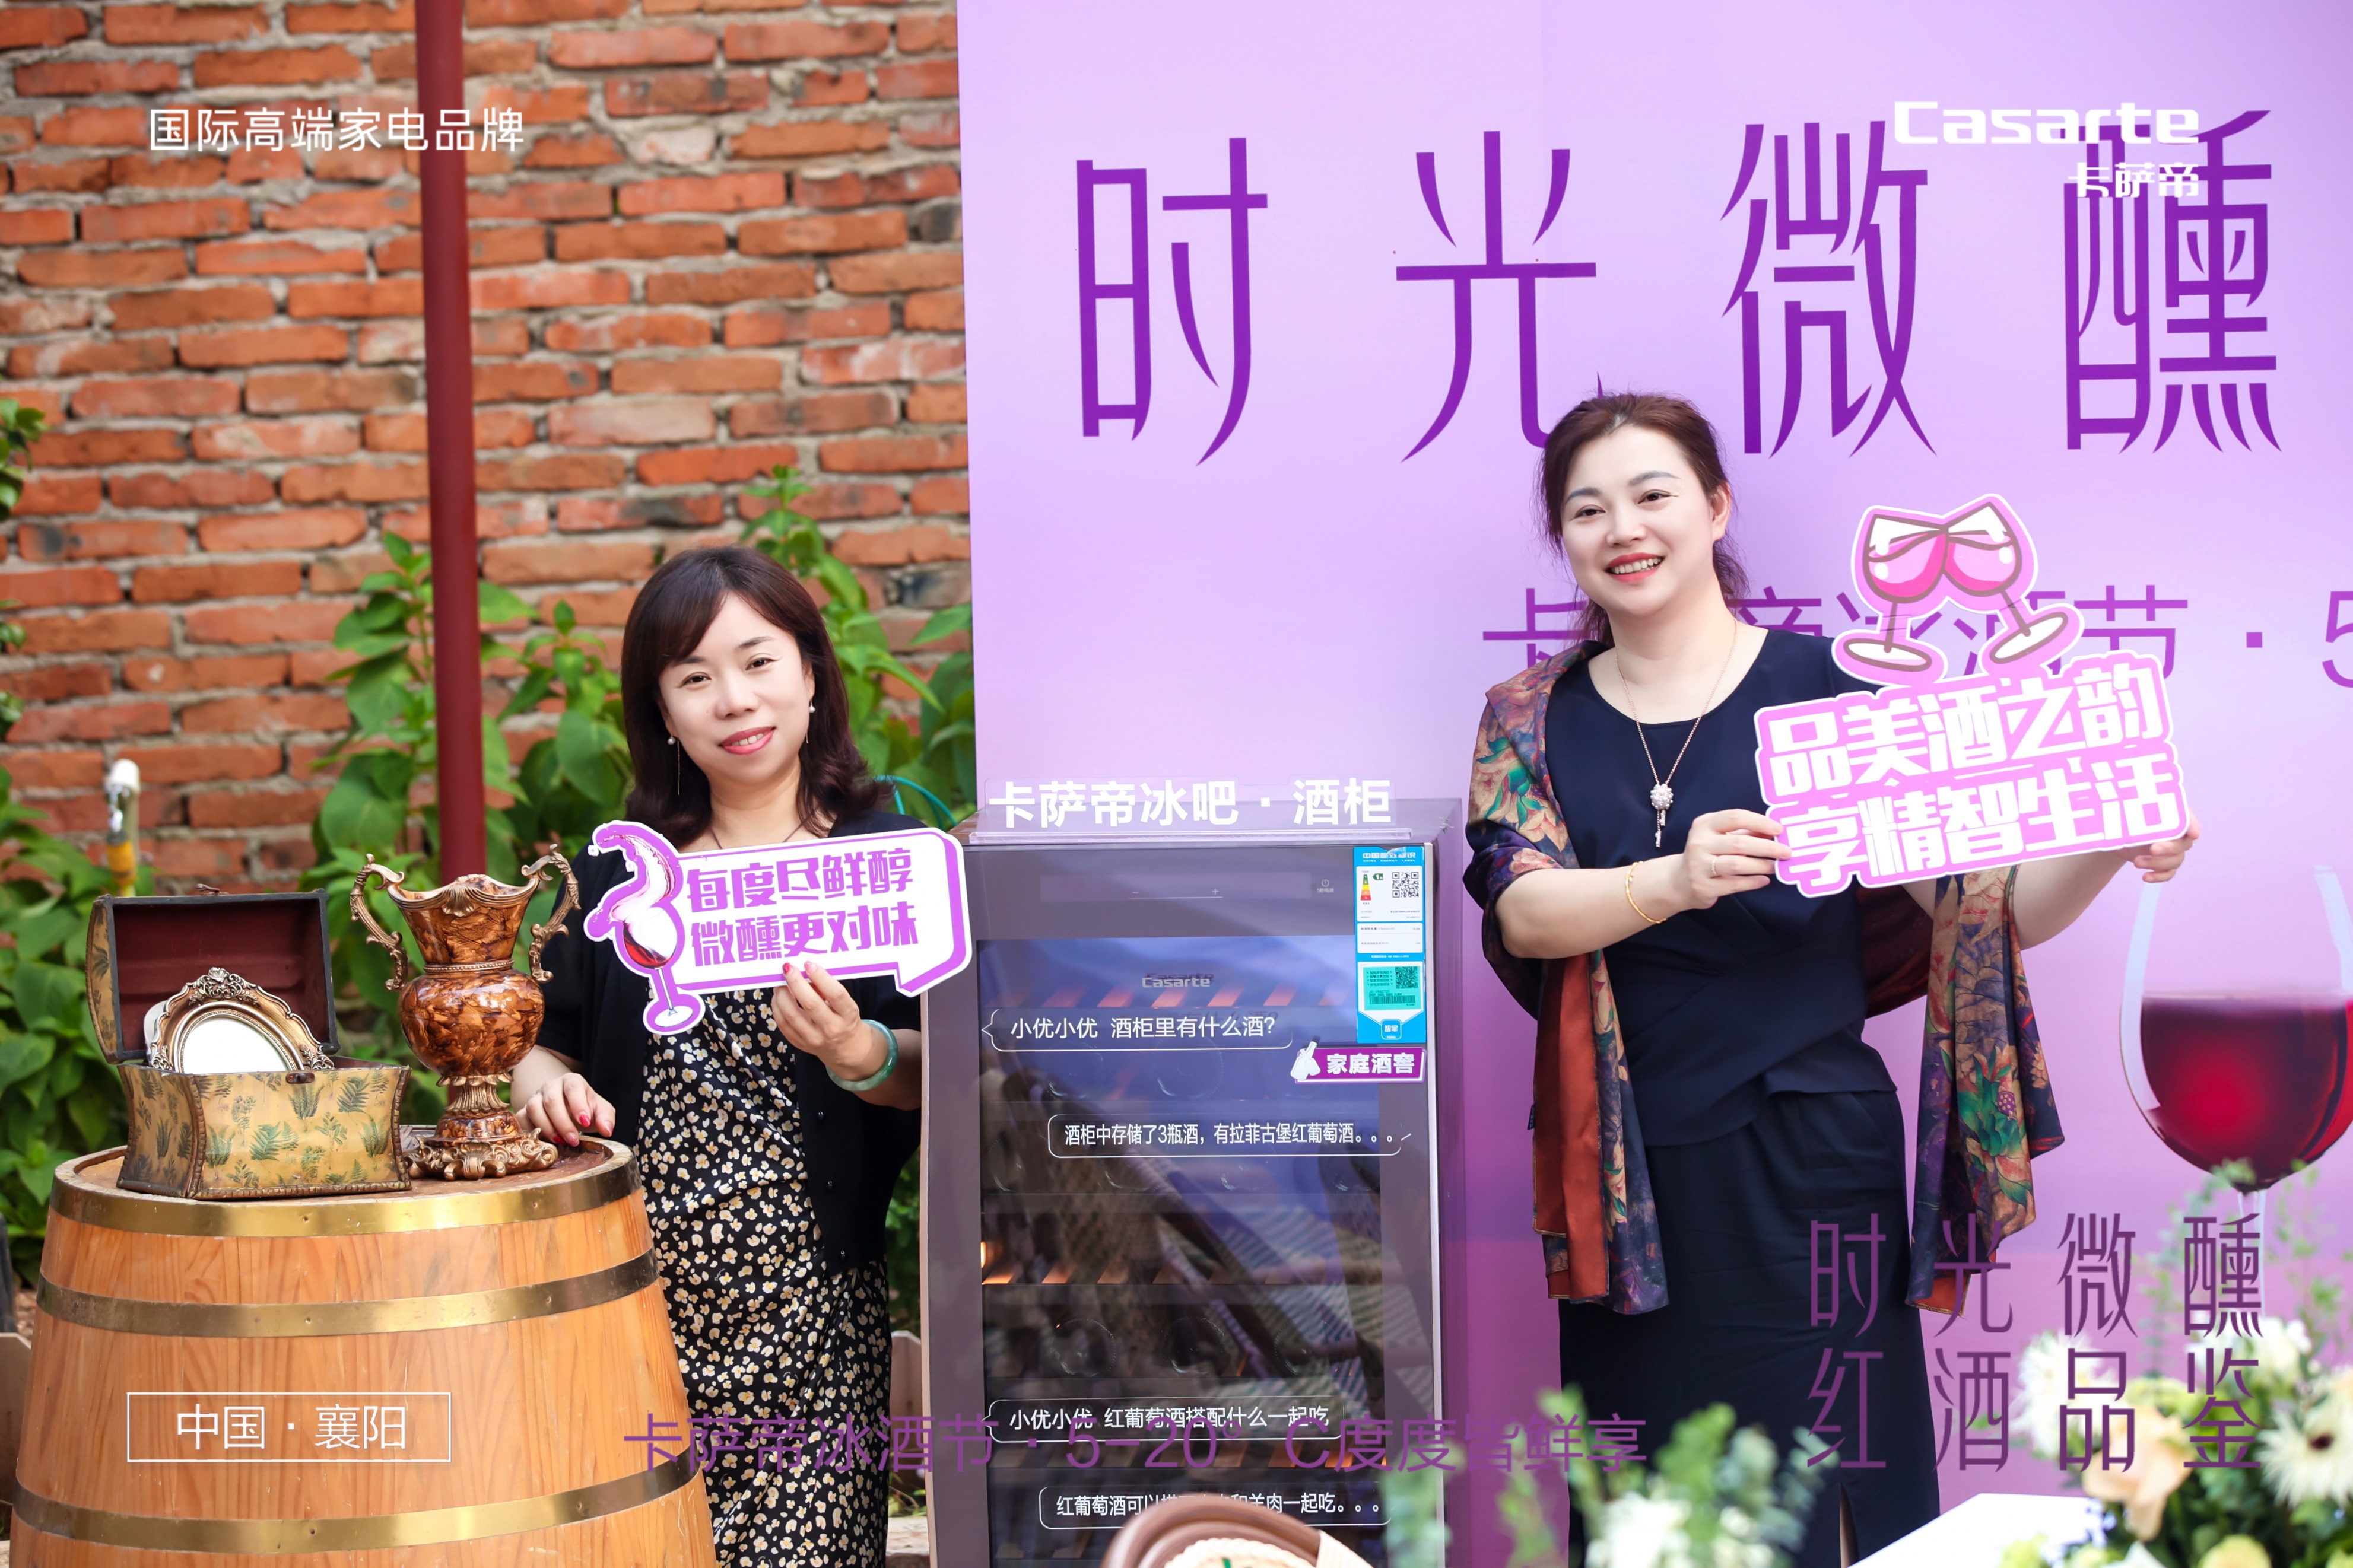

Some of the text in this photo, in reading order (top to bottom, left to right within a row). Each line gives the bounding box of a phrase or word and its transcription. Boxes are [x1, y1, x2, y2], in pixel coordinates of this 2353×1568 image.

[1075, 109, 2283, 467] 时光微醺
[1768, 662, 2164, 797] 品美酒之韵
[1784, 752, 2181, 888] 享精智生活
[685, 847, 914, 913] 每度尽鲜醇
[690, 900, 919, 968] 微醺更对味
[1142, 977, 1211, 988] Casarte
[1010, 1017, 1098, 1039] 小优小优
[1326, 1052, 1415, 1074] 家庭酒窖
[1009, 1405, 1329, 1430] 小优小优 红葡萄酒搭配什么一起吃
